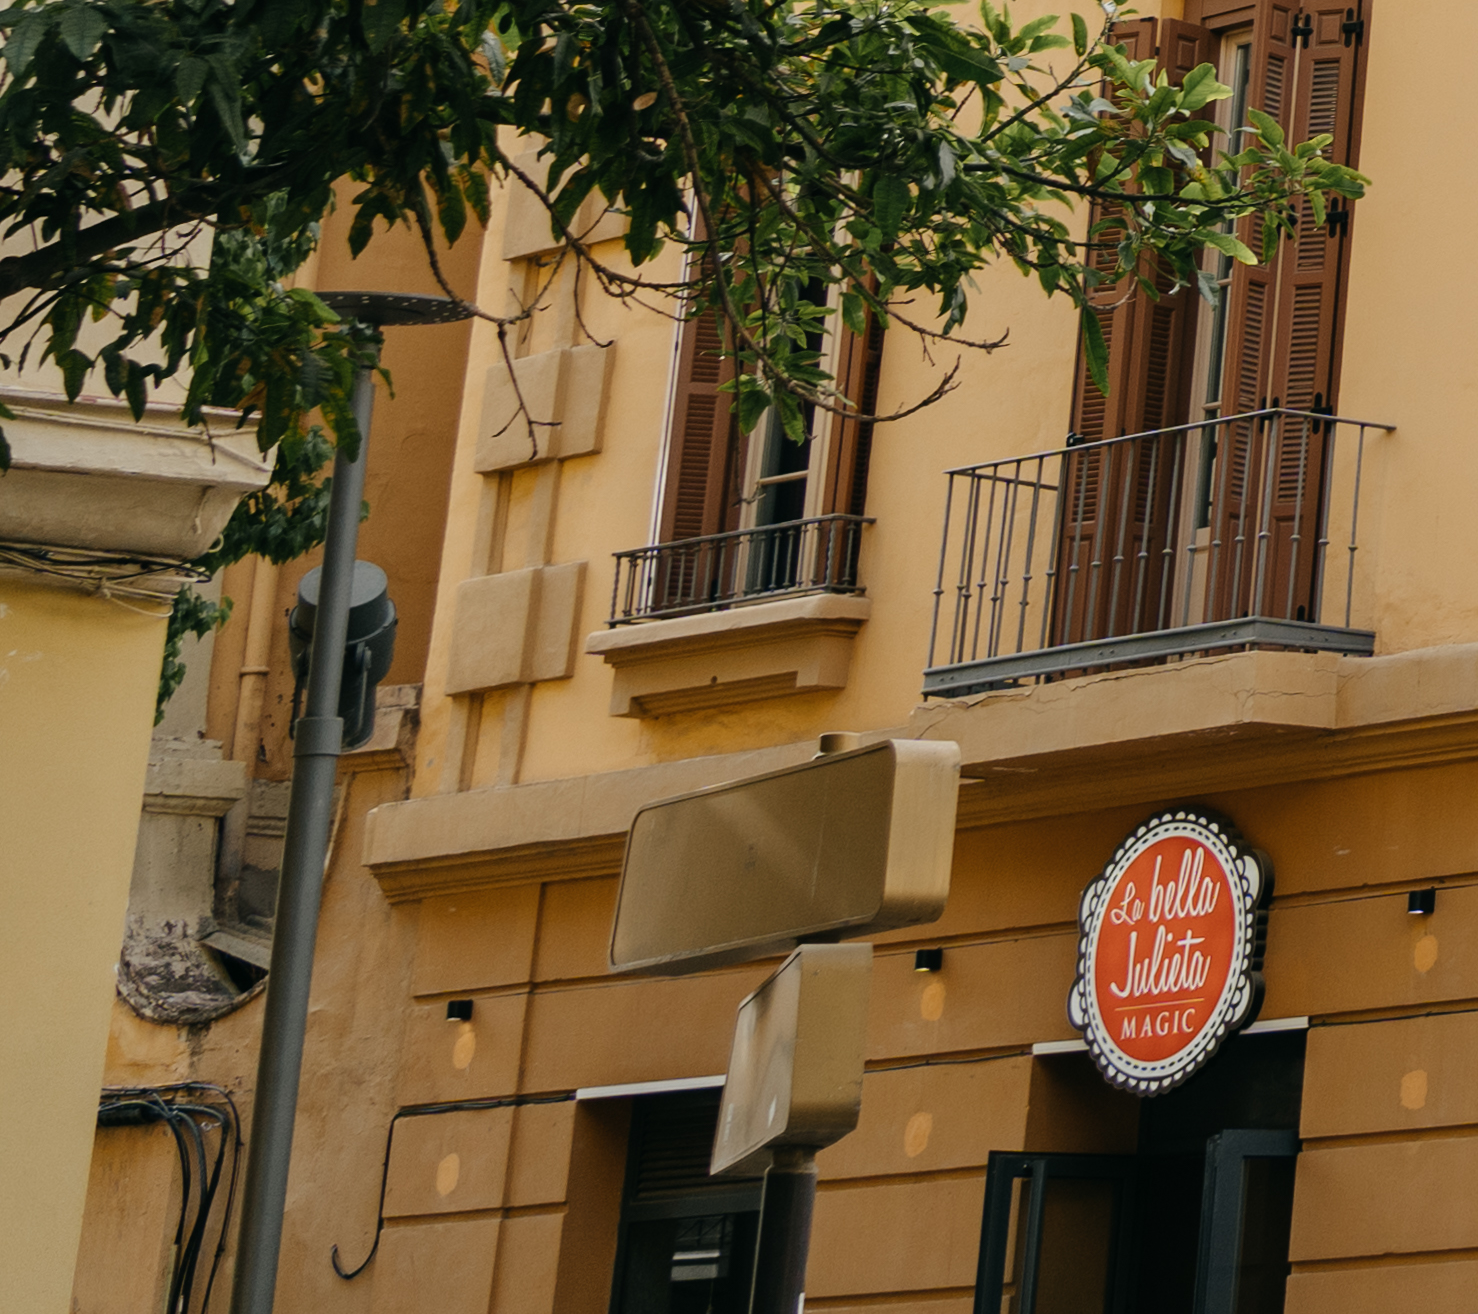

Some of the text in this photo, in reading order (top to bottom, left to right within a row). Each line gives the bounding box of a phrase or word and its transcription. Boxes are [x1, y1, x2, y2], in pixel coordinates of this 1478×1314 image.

[1110, 846, 1221, 925] La bella
[1109, 925, 1212, 998] Julieta
[1119, 1008, 1197, 1041] MAGIC
